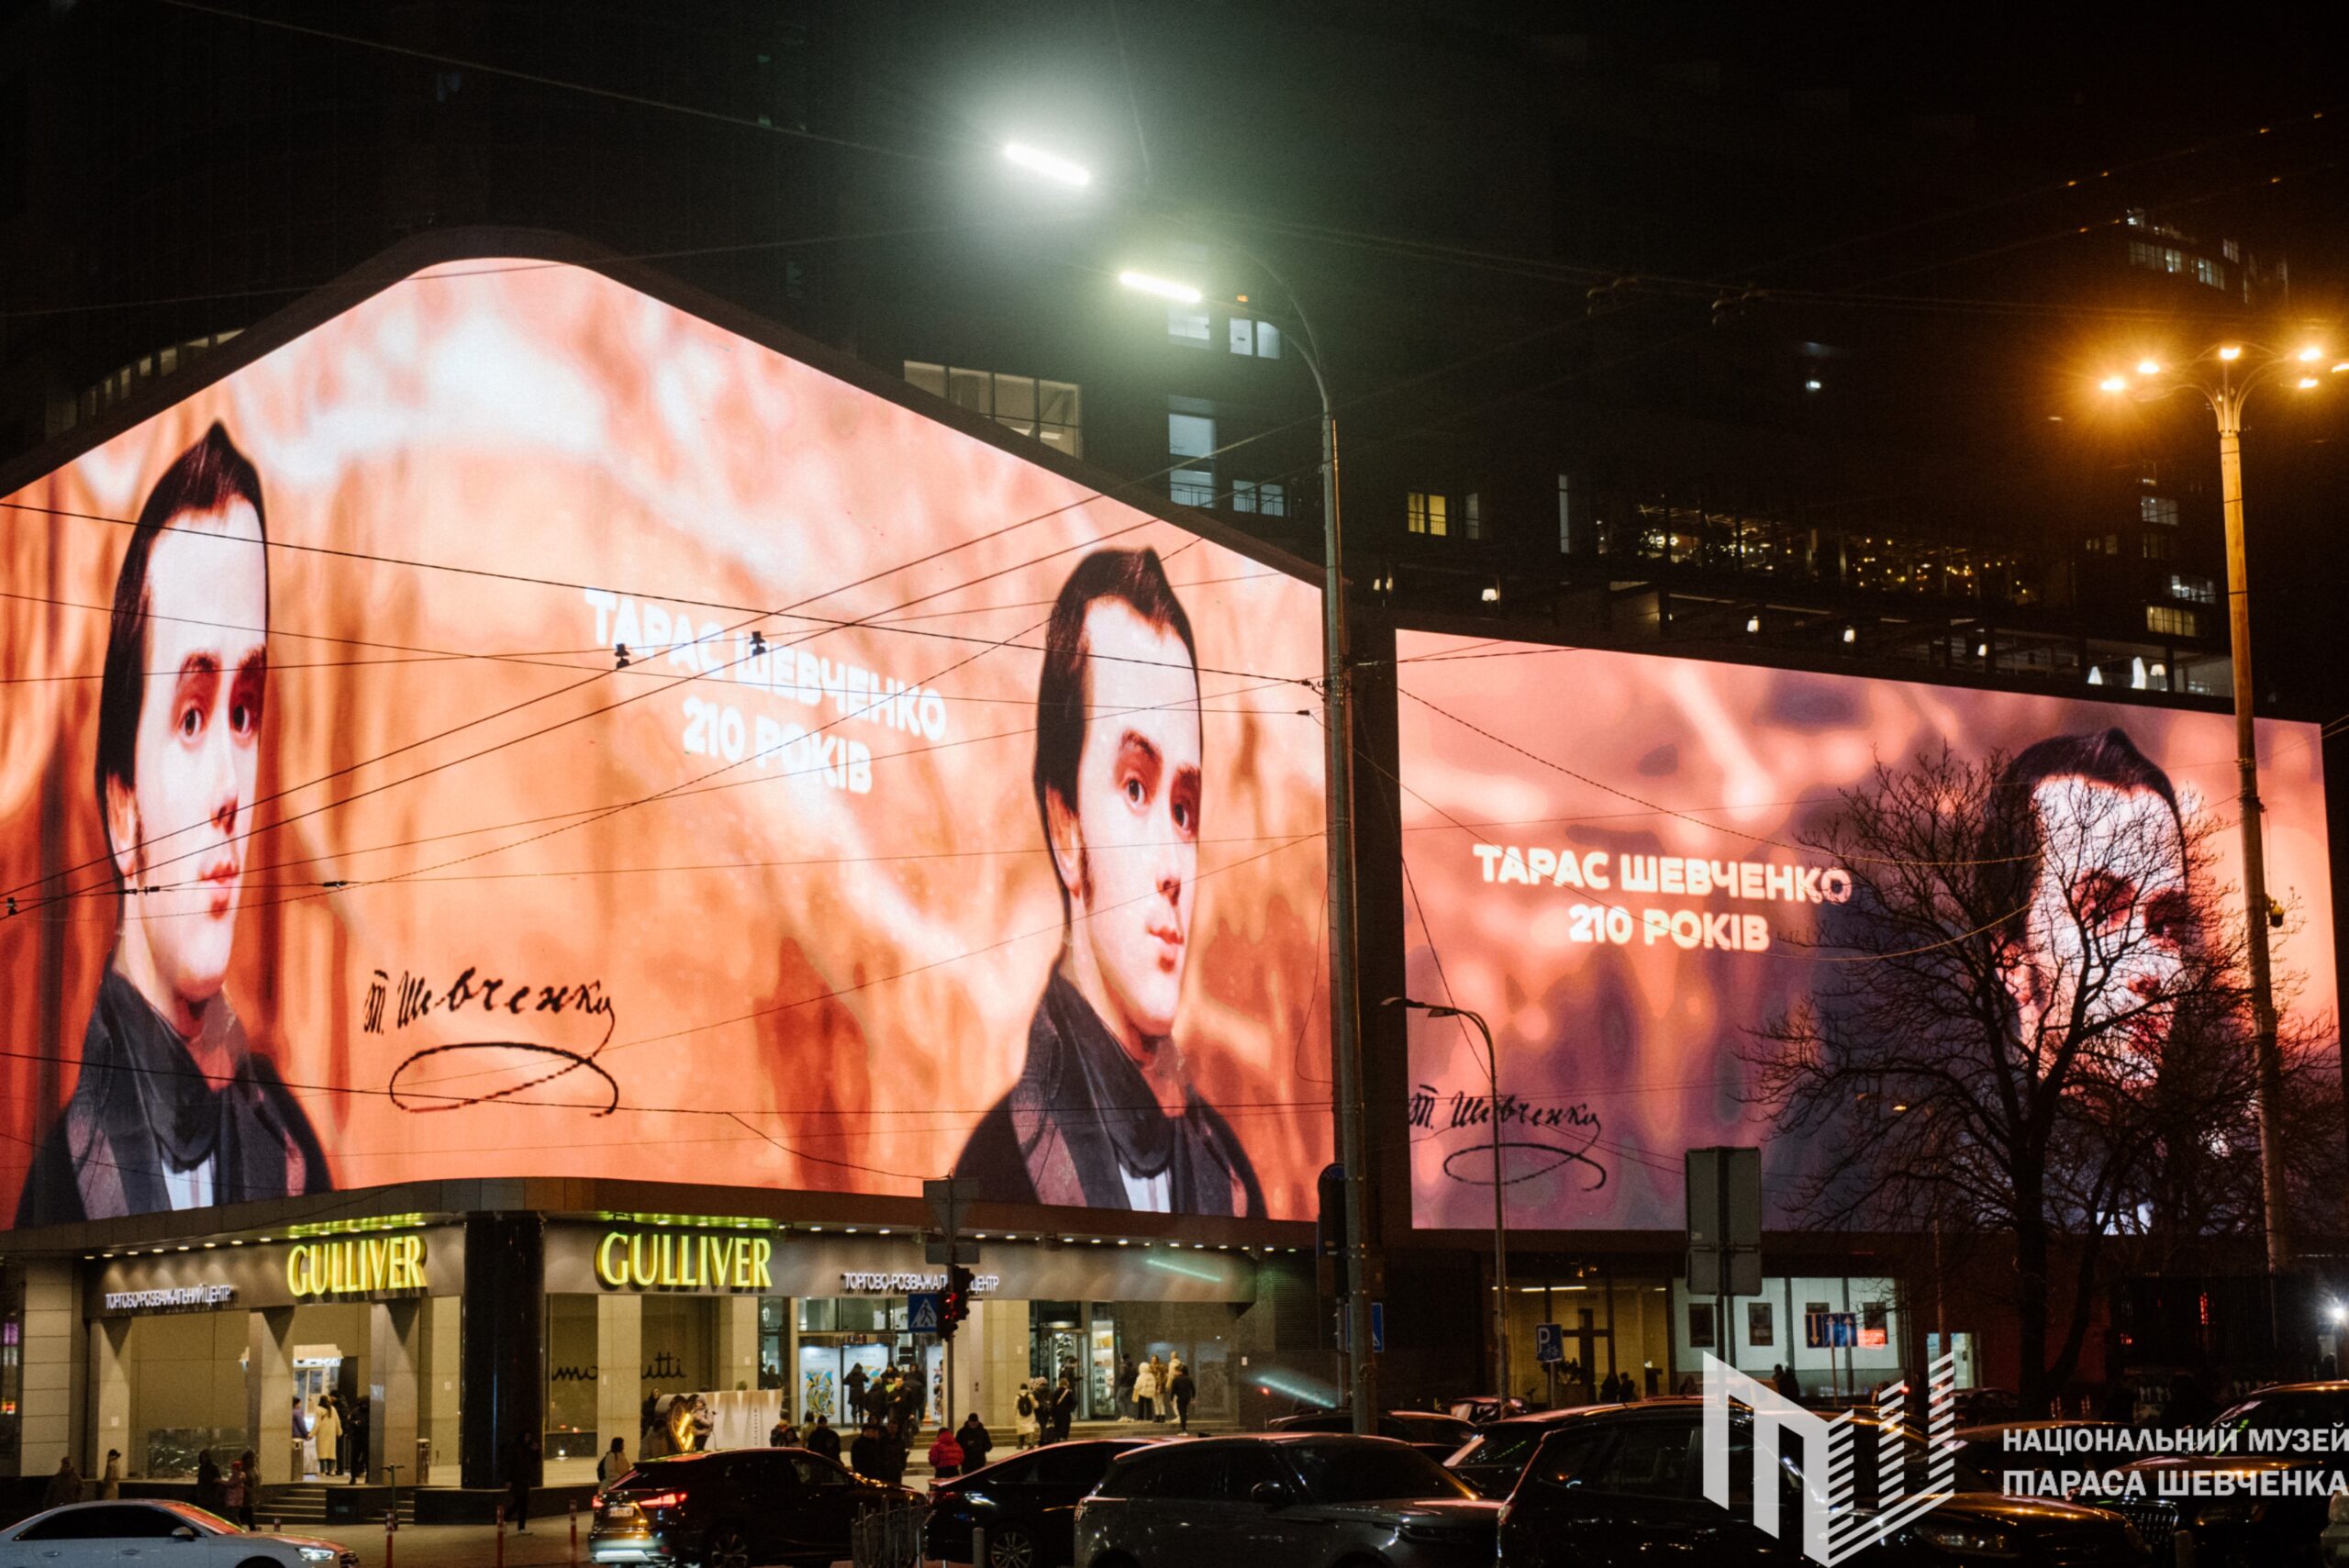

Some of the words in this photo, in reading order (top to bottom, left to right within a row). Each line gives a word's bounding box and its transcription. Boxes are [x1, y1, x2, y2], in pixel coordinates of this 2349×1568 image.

[584, 586, 725, 676] ТАРАС
[734, 633, 946, 741] ШЕВЧЕНКО
[683, 695, 746, 763] 210
[754, 714, 873, 795] РОКІВ
[1473, 843, 1610, 890] ТАРАС
[1620, 854, 1853, 904] ШЕВЧЕНКО
[1568, 904, 1633, 944] 210
[1642, 908, 1770, 951] РОКІВ
[286, 1236, 427, 1297] GULLIVER
[596, 1231, 773, 1288] GULLIVER
[842, 1273, 949, 1291] ТОРГОВО-РОЗВАЖАЛ
[969, 1274, 999, 1295] ЦЕНТР
[1537, 1327, 1551, 1353] P
